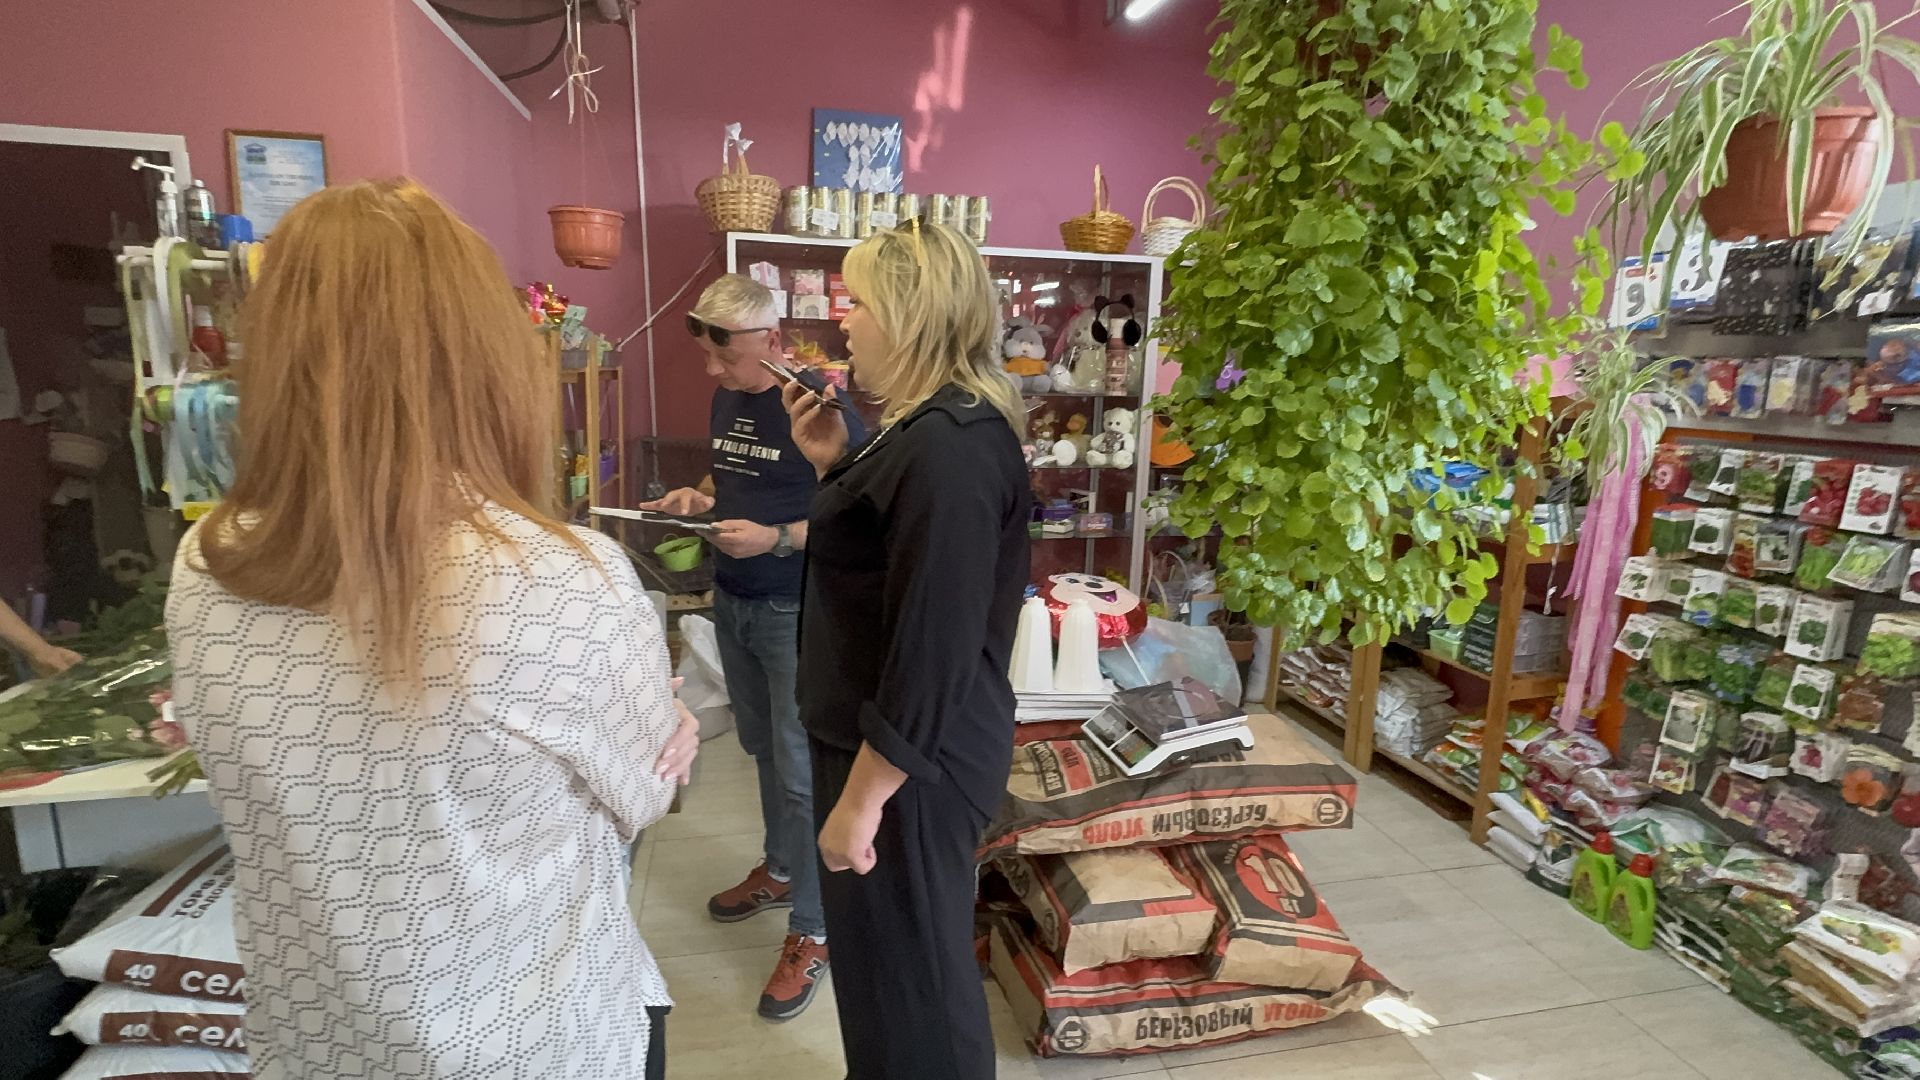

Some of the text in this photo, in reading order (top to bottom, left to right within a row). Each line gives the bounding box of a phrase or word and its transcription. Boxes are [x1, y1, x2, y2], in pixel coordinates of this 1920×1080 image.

[722, 440, 750, 455] TAILOR
[749, 445, 781, 461] DENIM
[1082, 804, 1268, 844] БЕРЁЗОВЫЙ УГОЛЬ
[1244, 855, 1305, 898] 10
[124, 964, 157, 980] 40
[119, 1023, 150, 1038] 40
[1135, 1003, 1254, 1041] БЕРЁЗОВЫЙ
